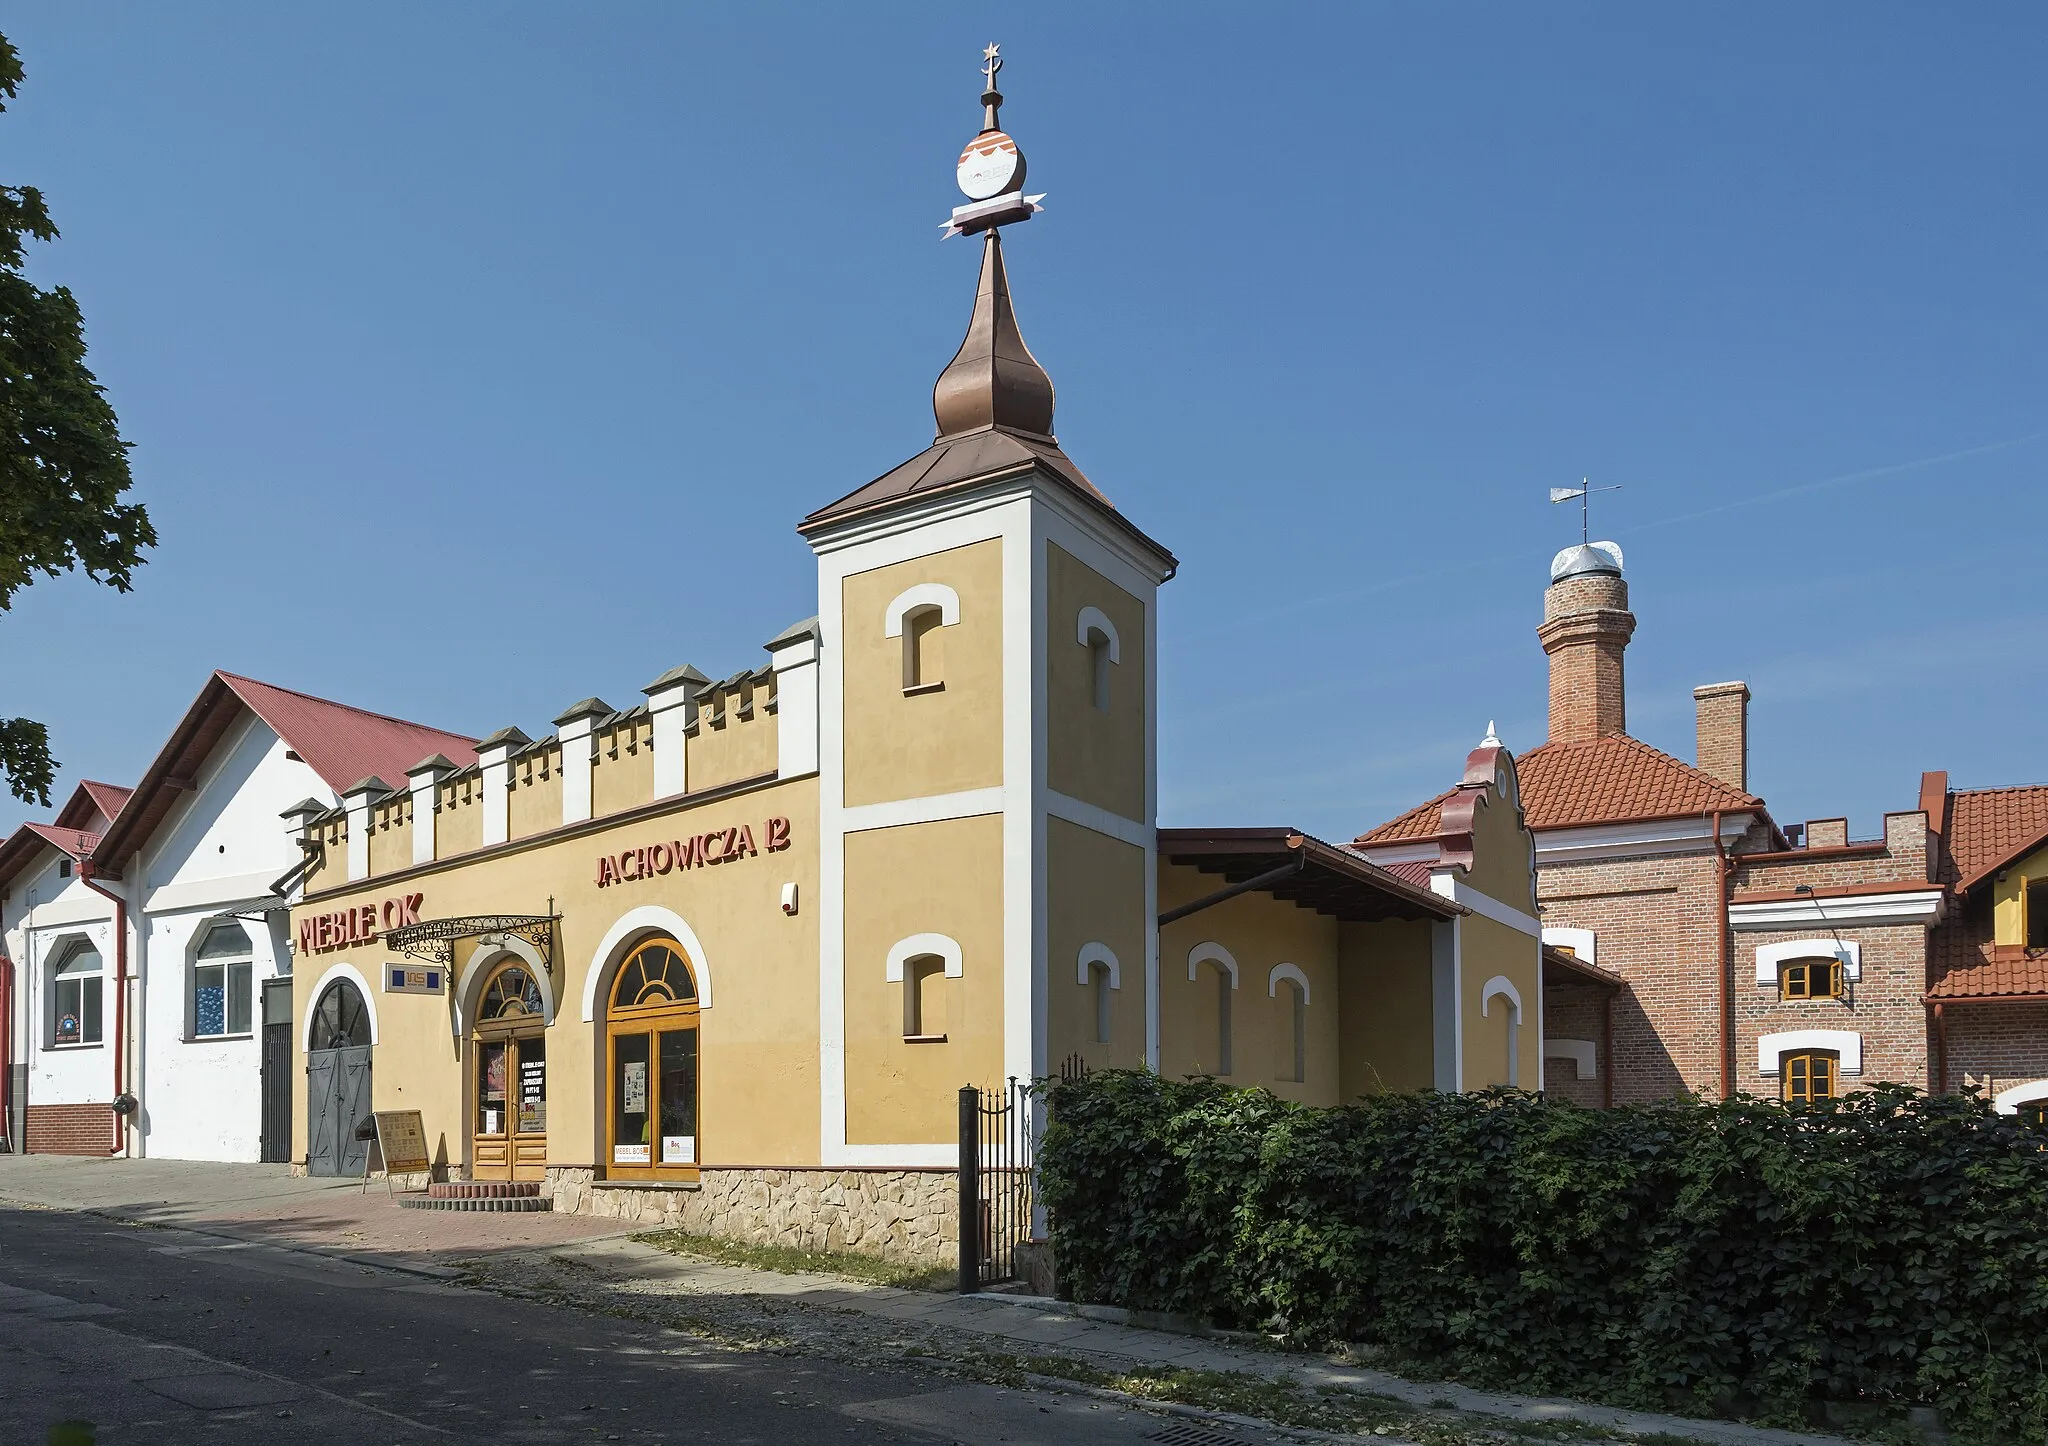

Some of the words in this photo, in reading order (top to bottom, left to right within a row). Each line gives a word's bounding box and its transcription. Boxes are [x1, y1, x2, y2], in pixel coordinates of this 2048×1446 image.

[593, 824, 758, 888] JACHOWICZA
[763, 816, 791, 853] 12
[299, 904, 378, 956] MEBLE
[381, 893, 424, 930] OK
